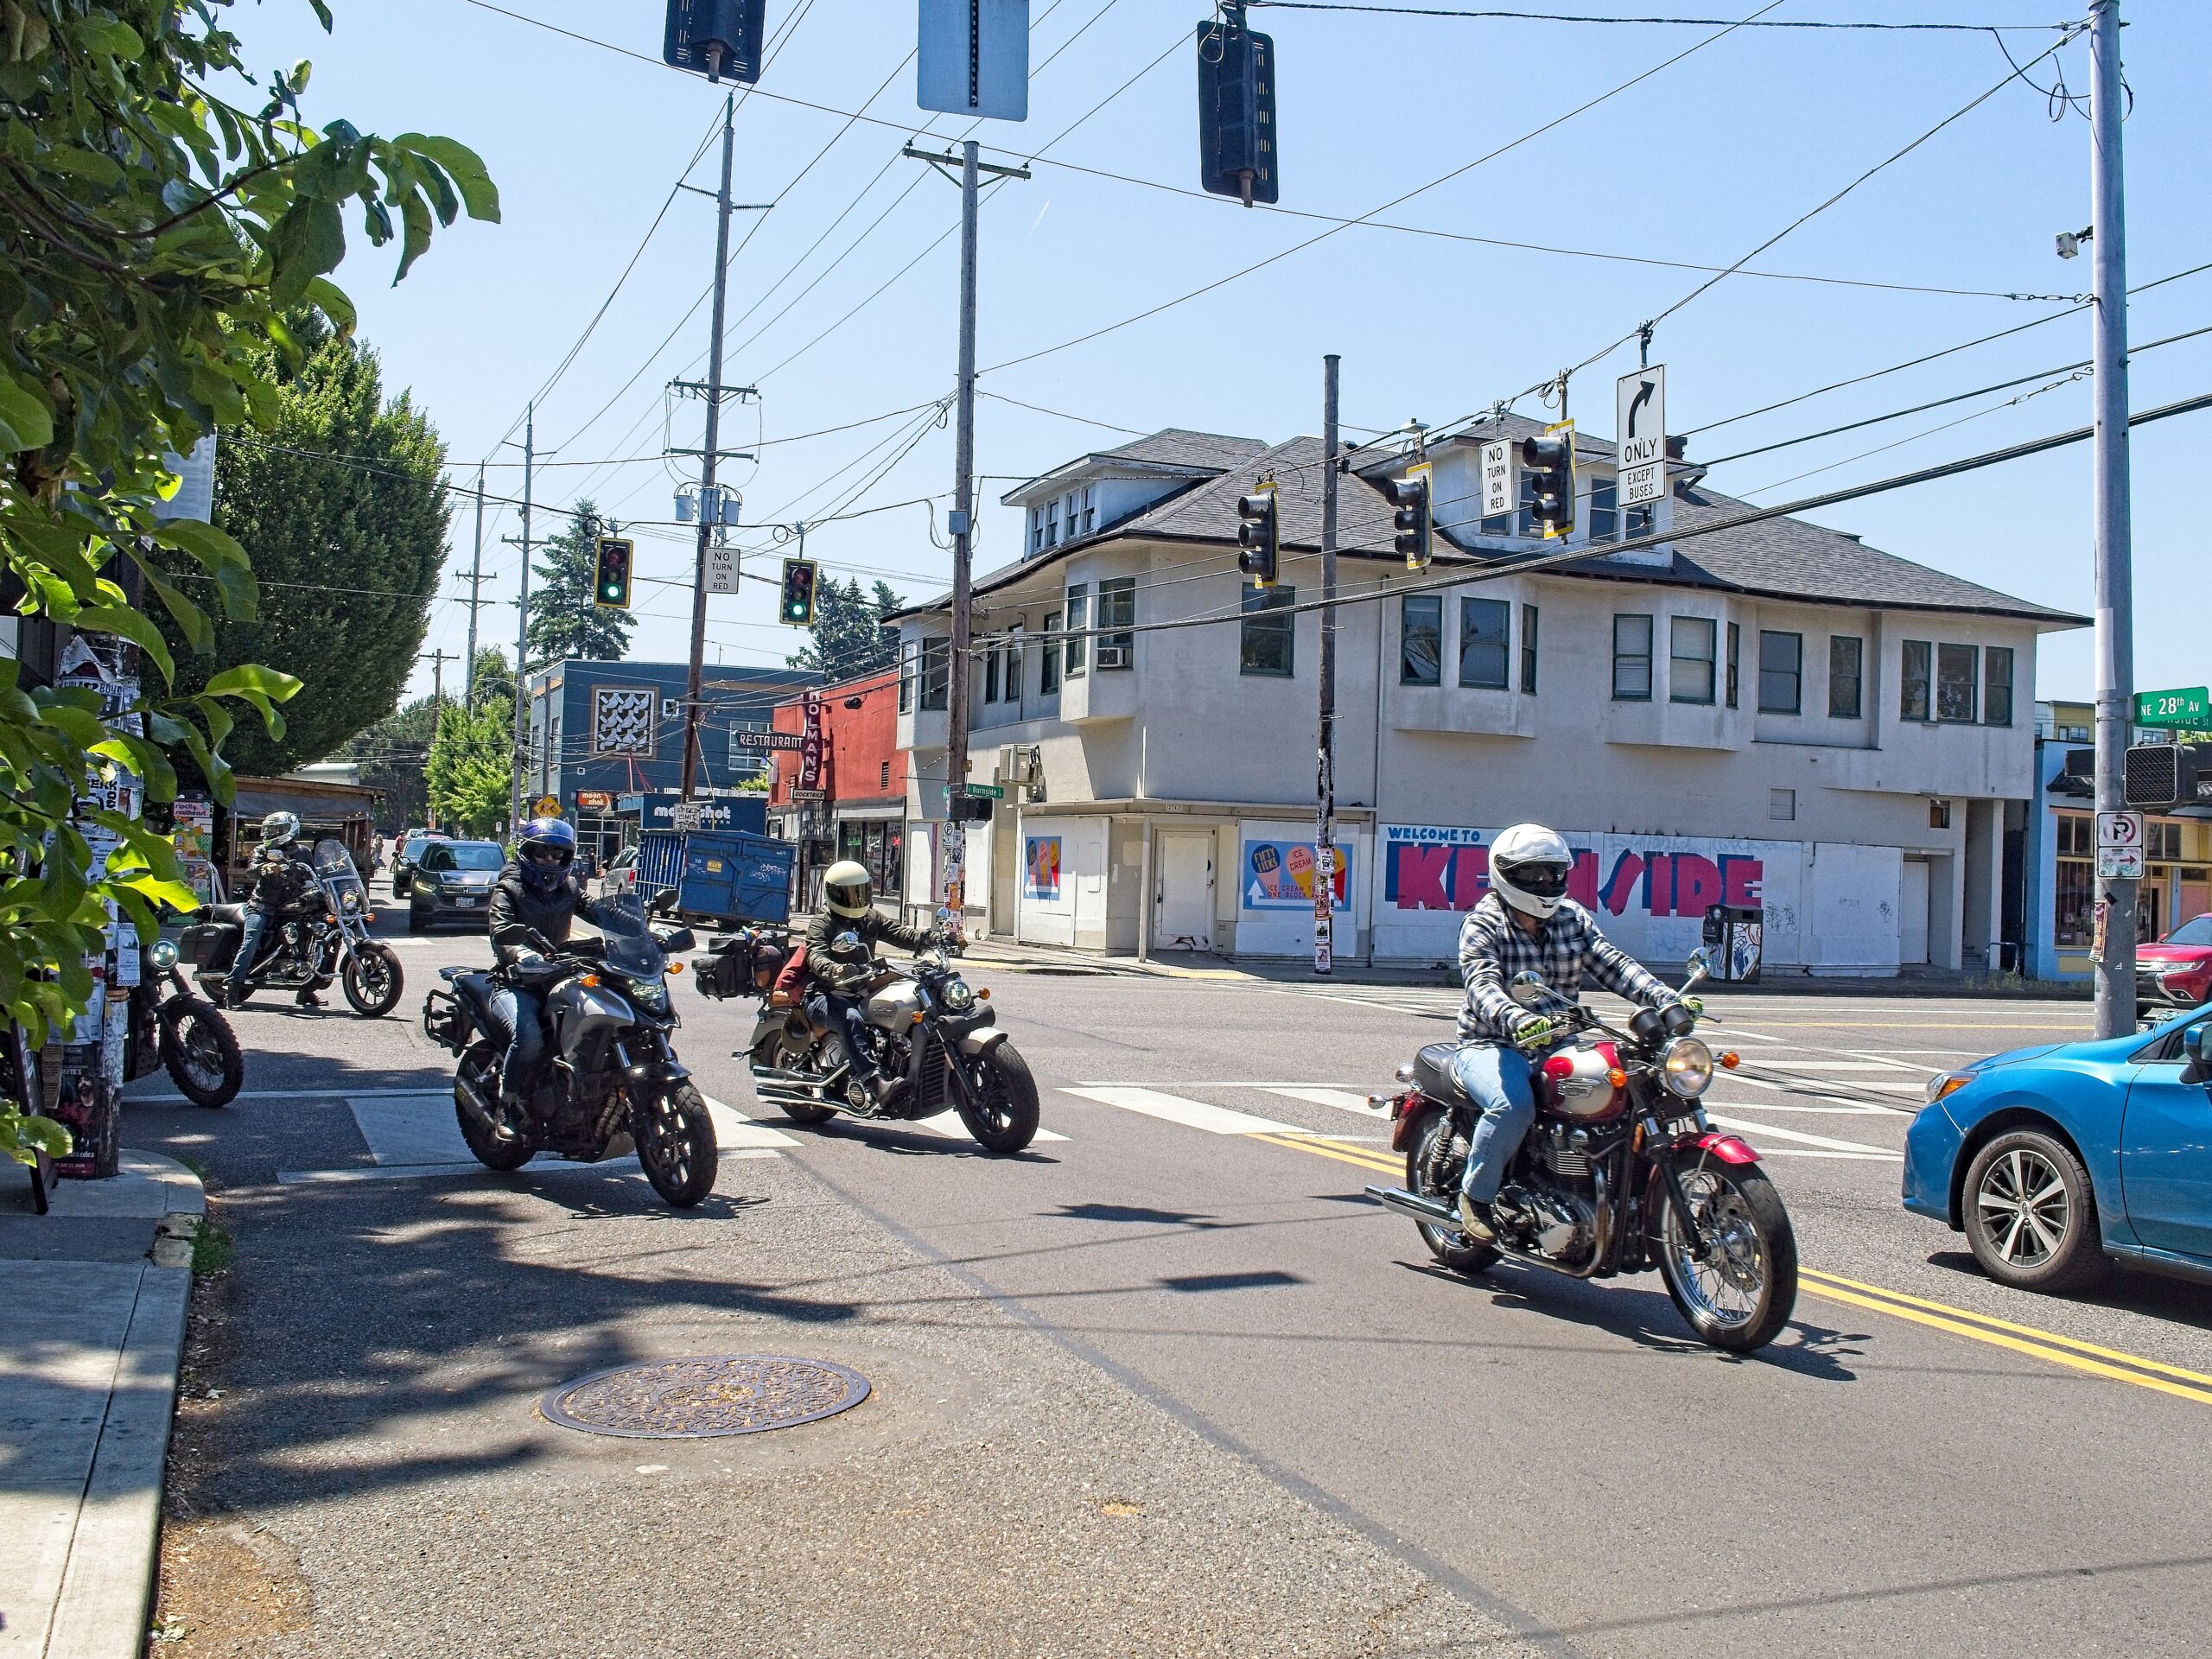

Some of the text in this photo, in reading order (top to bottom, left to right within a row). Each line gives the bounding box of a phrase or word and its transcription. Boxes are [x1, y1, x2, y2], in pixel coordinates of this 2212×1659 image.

[1488, 447, 1503, 462] NO
[1624, 437, 1657, 463] ONLY
[1487, 466, 1506, 480] TURN
[1627, 467, 1655, 486] EXCEPT
[1491, 480, 1502, 493] ON
[1629, 483, 1654, 500] BUSES
[1491, 497, 1504, 510] RED
[714, 552, 730, 561] NO
[711, 563, 733, 571] TURN
[2140, 704, 2152, 716] NE
[2158, 696, 2184, 715] 28th
[740, 734, 804, 748] RESTAURANT
[804, 692, 820, 781] HOLMAN'S
[972, 786, 997, 797] Burnside
[654, 805, 731, 819] moshot
[1388, 827, 1480, 842] WELCOME TO
[1253, 847, 1275, 863] FIFTY
[1292, 849, 1304, 860] ICE
[1257, 857, 1278, 873] LICKS
[1289, 857, 1312, 871] CREAM
[1386, 841, 1764, 918] KENSIDE
